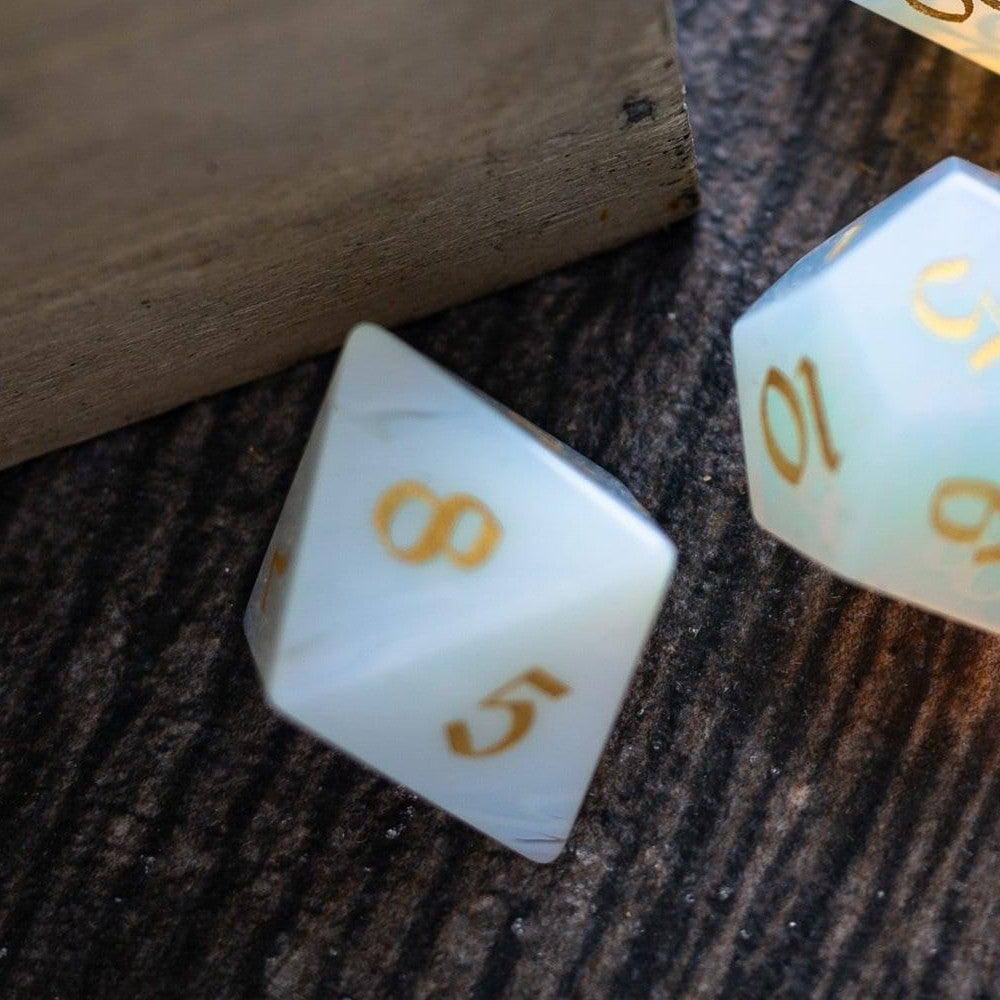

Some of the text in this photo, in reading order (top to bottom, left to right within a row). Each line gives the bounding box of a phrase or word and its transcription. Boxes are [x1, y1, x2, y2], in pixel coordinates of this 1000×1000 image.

[760, 356, 841, 486] 10
[372, 478, 503, 572] 8
[443, 666, 573, 760] 5
